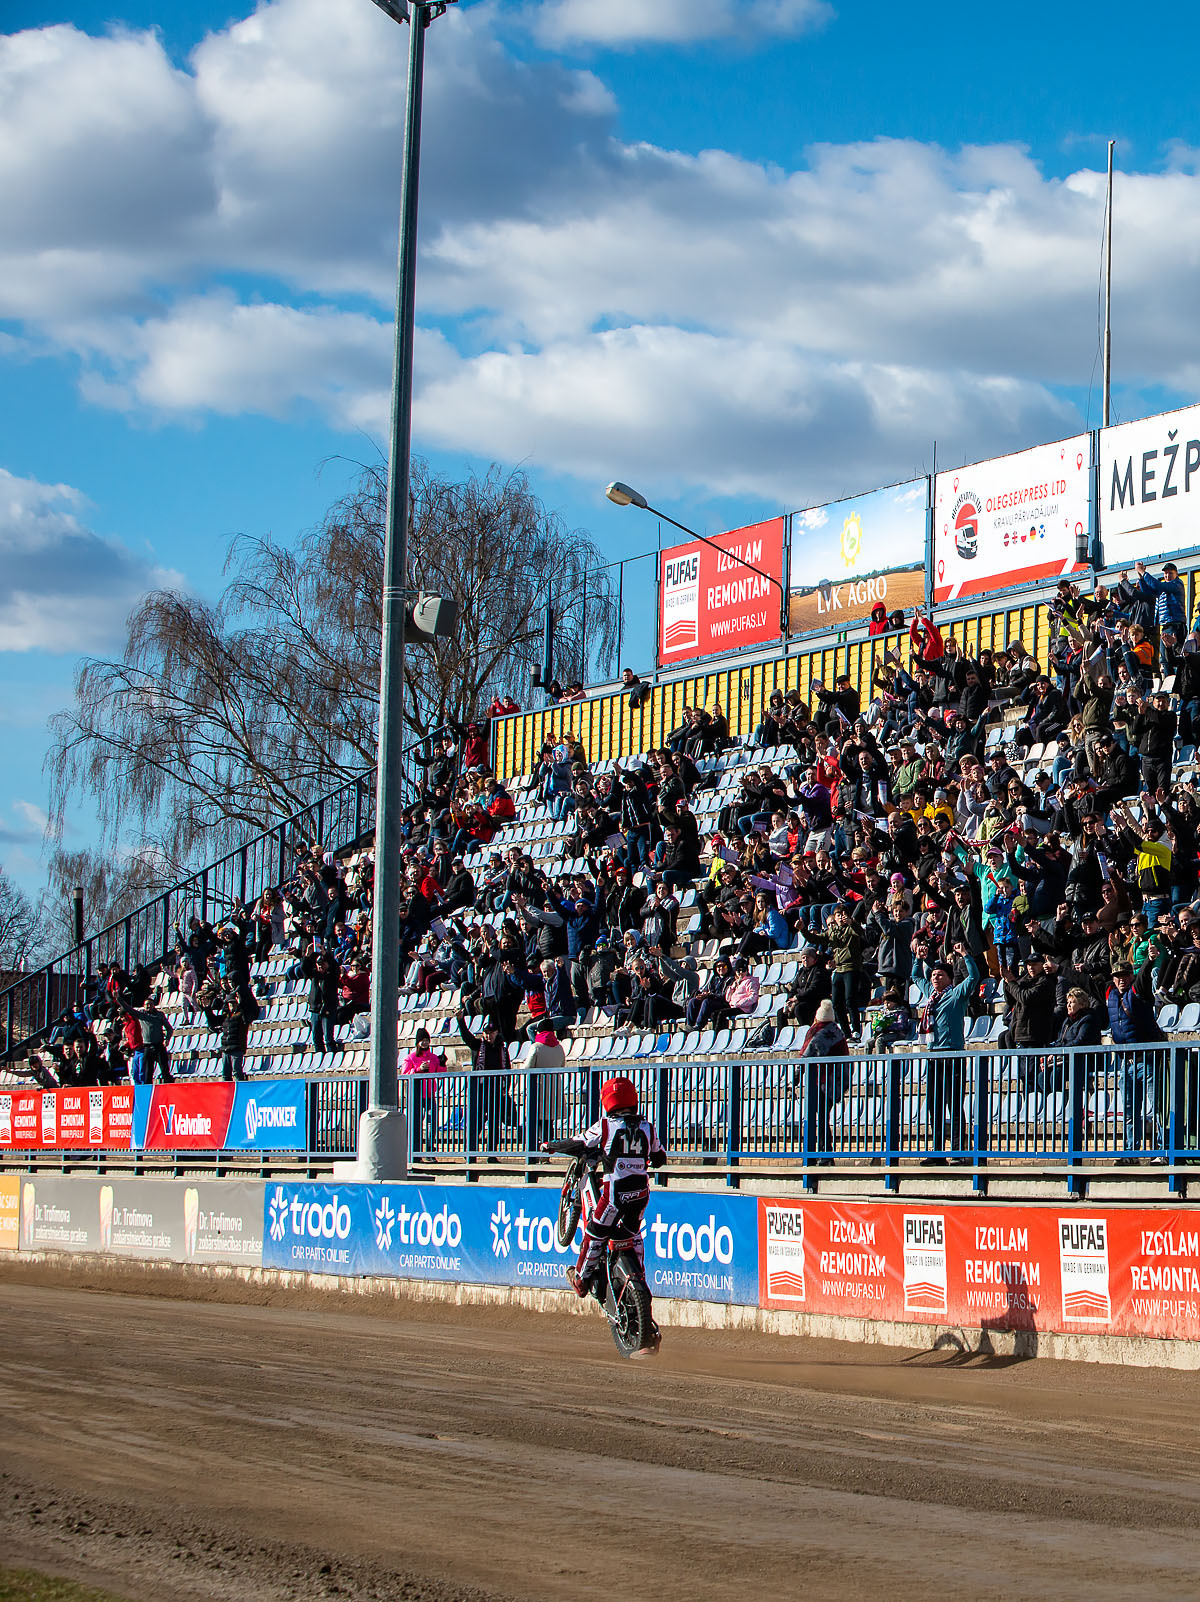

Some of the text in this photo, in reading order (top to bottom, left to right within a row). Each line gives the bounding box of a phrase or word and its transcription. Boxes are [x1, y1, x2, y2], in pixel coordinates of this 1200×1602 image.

[986, 479, 1067, 512] OLEGSEXPRESS LTD
[717, 539, 762, 573] IZCILAM
[665, 557, 698, 588] PUFAS
[707, 573, 771, 611] REMONTAM
[817, 575, 887, 614] LVK AGRO
[710, 611, 767, 638] WWW.PUFAS.LV
[174, 1113, 211, 1135] Valvoline
[257, 1107, 297, 1127] STOKKER
[620, 1134, 642, 1154] 14
[113, 1207, 153, 1227] Dr. Trofimova
[199, 1211, 243, 1231] Dr. Trofimova
[289, 1194, 351, 1240] trodo
[398, 1204, 462, 1247] trodo
[767, 1212, 802, 1236] PUFAS
[651, 1213, 733, 1264] trodo
[830, 1220, 876, 1245] IZCILAM
[906, 1219, 943, 1245] PUFAS
[975, 1226, 1028, 1252] IZCILAM
[1061, 1224, 1105, 1250] PUFAS
[1141, 1231, 1199, 1257] IZCILAM
[242, 1237, 263, 1253] prakse
[291, 1245, 350, 1264] CAR PARTS ONLINE
[400, 1254, 461, 1271] CAR PARTS ONLINE
[517, 1262, 533, 1276] CAR
[533, 1263, 558, 1277] PARTS
[820, 1251, 886, 1277] REMONTAM
[905, 1256, 918, 1266] MADE
[925, 1256, 944, 1267] GERMANY
[965, 1259, 1040, 1286] REMONTAM
[1063, 1262, 1106, 1275] MADE IN GERMANY
[654, 1270, 674, 1285] CAR
[674, 1271, 702, 1288] PARTS
[822, 1279, 886, 1301] WWW.PUFAS.LV
[966, 1290, 1040, 1311] WWW.PUFAS.LV
